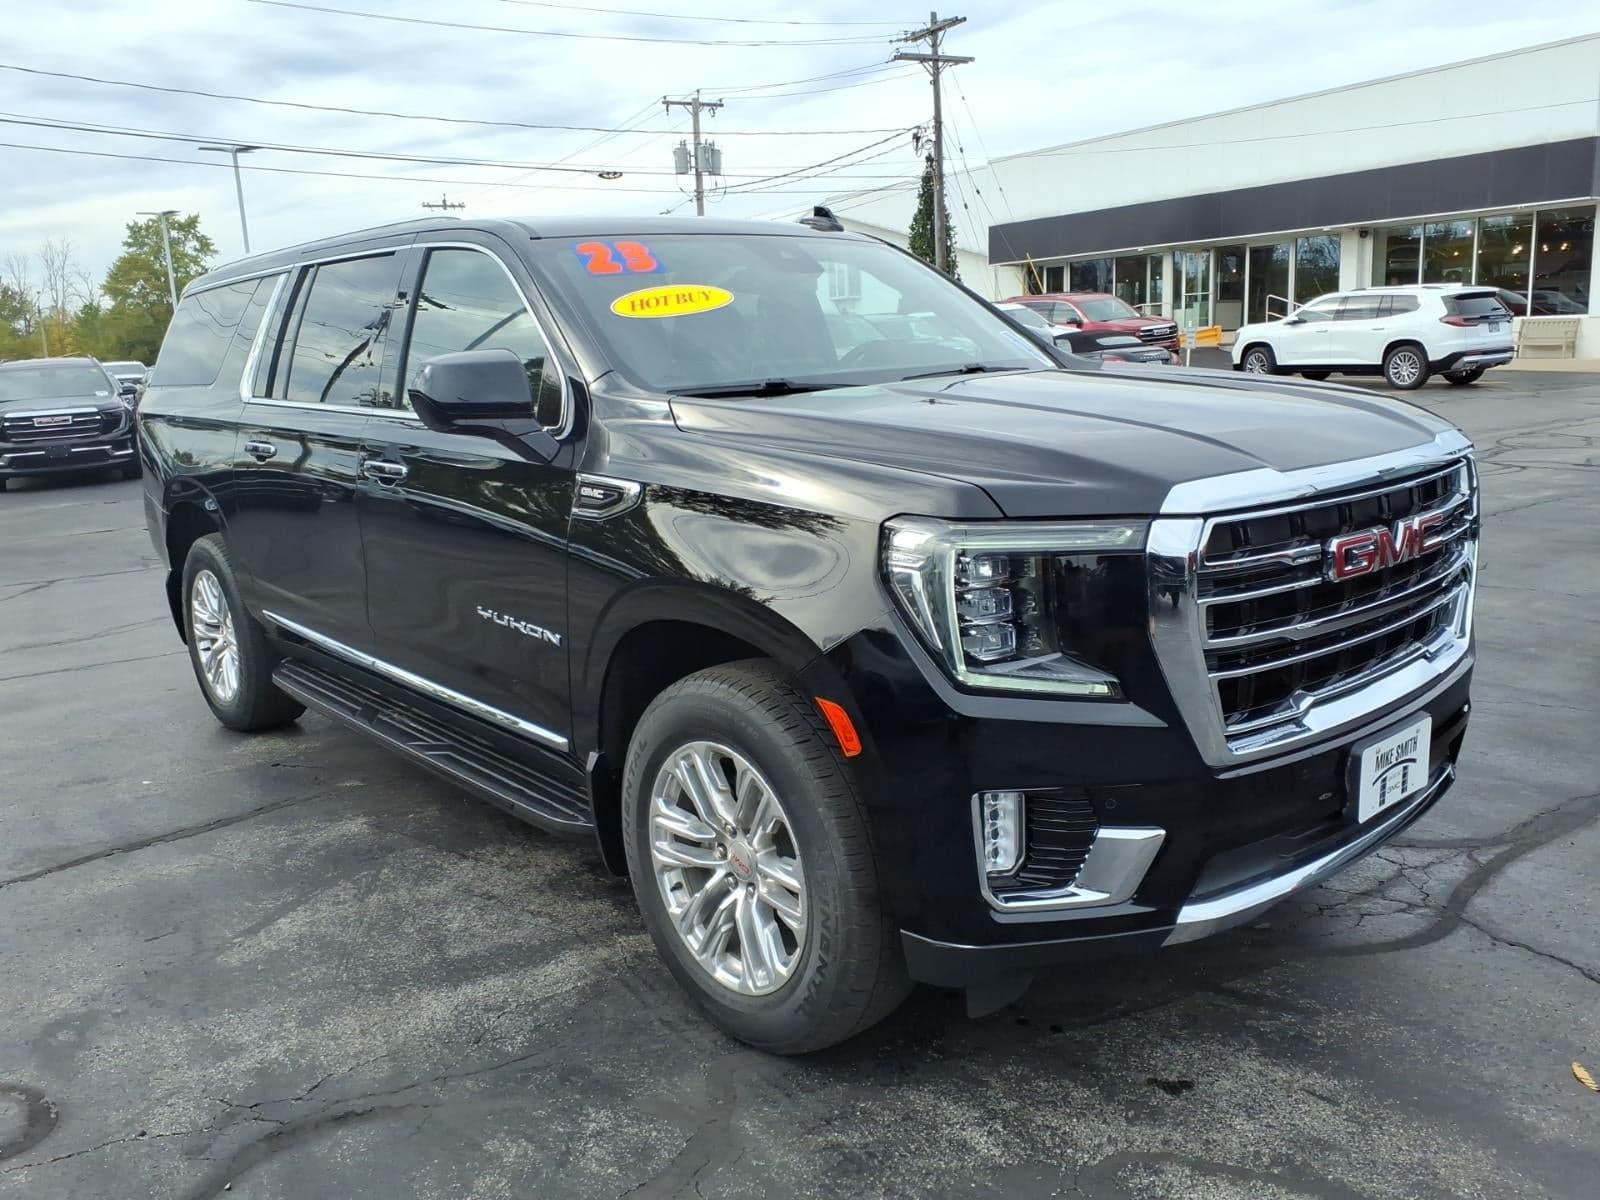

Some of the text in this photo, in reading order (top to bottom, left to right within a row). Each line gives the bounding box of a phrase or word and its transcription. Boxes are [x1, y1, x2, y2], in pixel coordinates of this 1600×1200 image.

[576, 241, 658, 275] 23
[630, 290, 713, 312] HOT BUY
[580, 487, 604, 499] GMC
[1328, 513, 1446, 583] GMC
[476, 605, 562, 647] YUKON
[1375, 735, 1418, 773] MIKE SMITH
